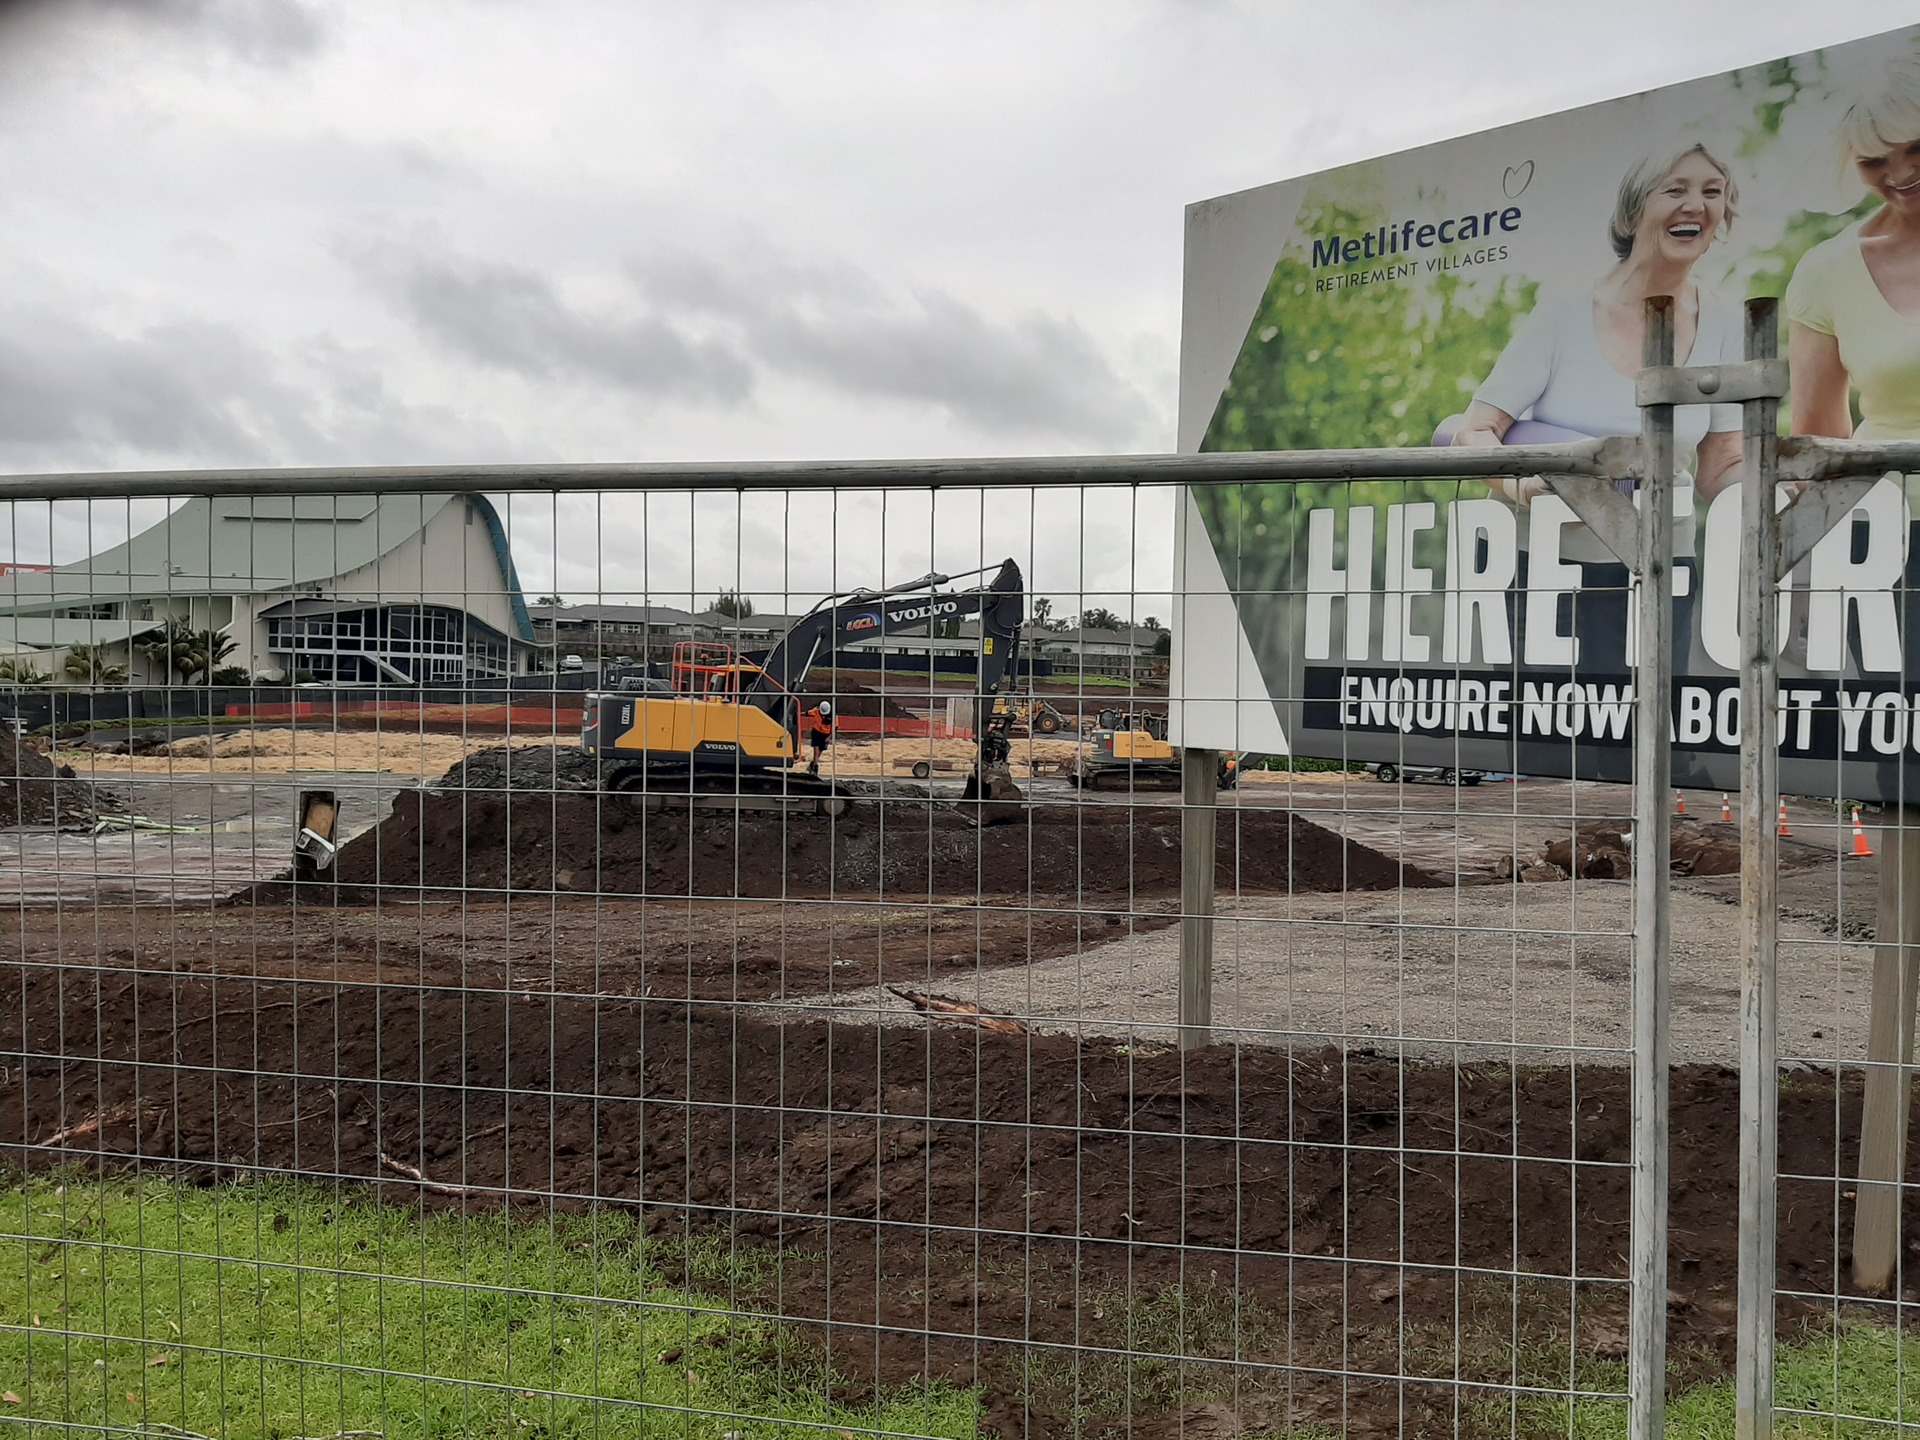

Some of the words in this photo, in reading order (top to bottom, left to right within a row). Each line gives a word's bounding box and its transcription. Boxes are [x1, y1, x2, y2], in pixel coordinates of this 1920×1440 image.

[1312, 205, 1522, 269] Metlifecare
[1315, 261, 1419, 293] RETIREMENT
[1426, 245, 1508, 272] VILLAGES
[1304, 494, 1583, 666] HERE
[887, 601, 957, 623] VOLVO
[1339, 676, 1511, 734] ENQUIRE
[1521, 681, 1634, 740] NOW
[1670, 686, 1822, 751] BOT
[1836, 690, 1920, 755] YO
[704, 743, 736, 751] VOLVO
